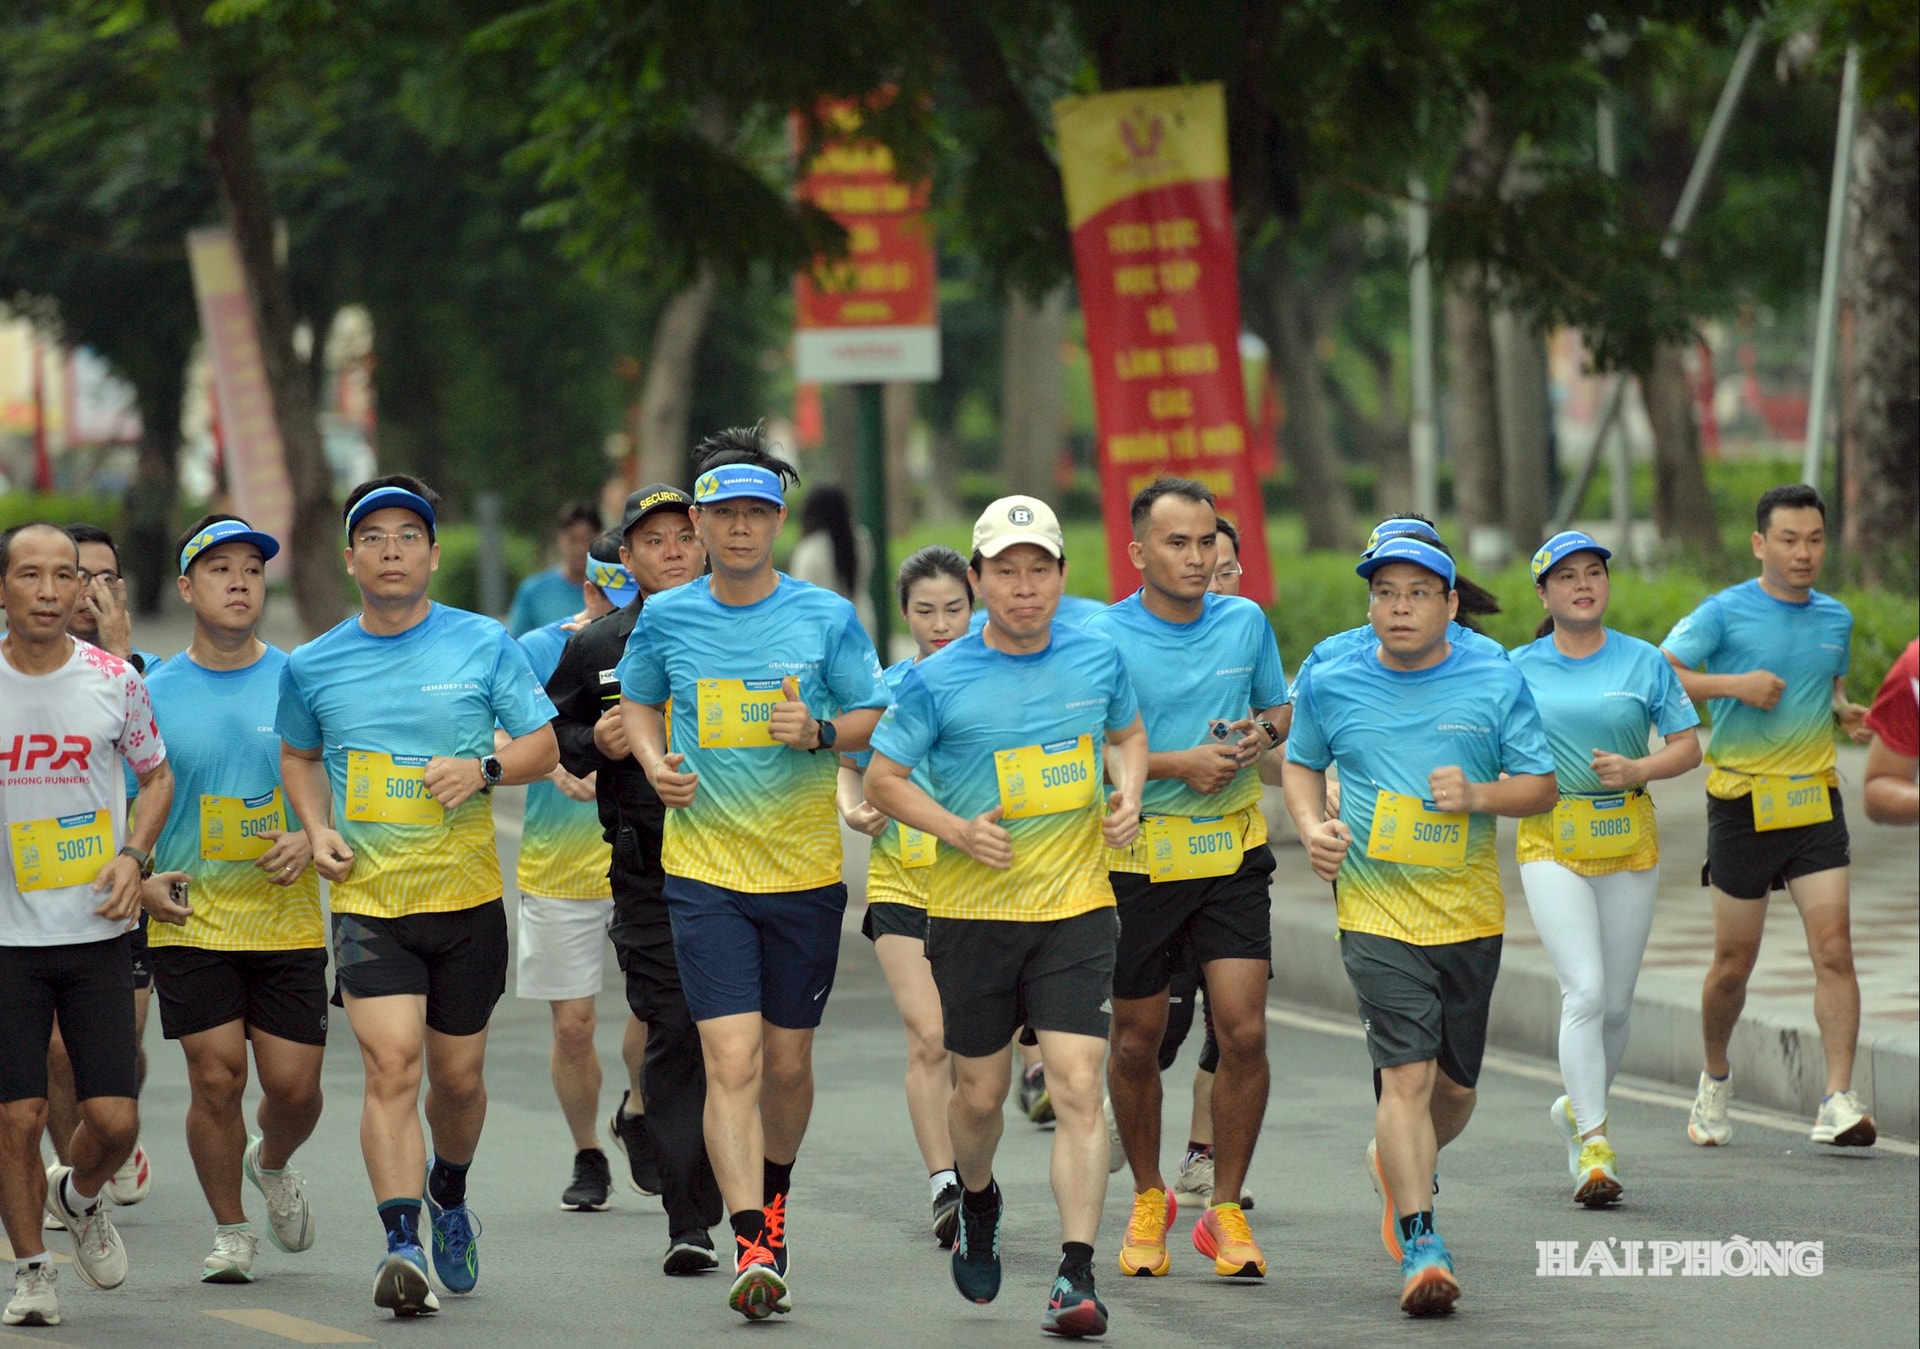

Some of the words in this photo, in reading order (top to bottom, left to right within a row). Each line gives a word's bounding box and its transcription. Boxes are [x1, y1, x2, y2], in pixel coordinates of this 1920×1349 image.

[640, 492, 683, 510] SECURITY
[1014, 510, 1028, 522] B
[422, 683, 462, 692] GEMADEPT
[0, 734, 92, 772] HPR
[8, 776, 42, 786] PHONG
[44, 776, 91, 784] RUNNERS
[1042, 760, 1087, 788] 50886
[240, 811, 279, 838] 50879
[1413, 822, 1460, 843] 50875
[1590, 817, 1630, 837] 50883
[56, 834, 102, 862] 50871
[1188, 832, 1233, 855] 50870
